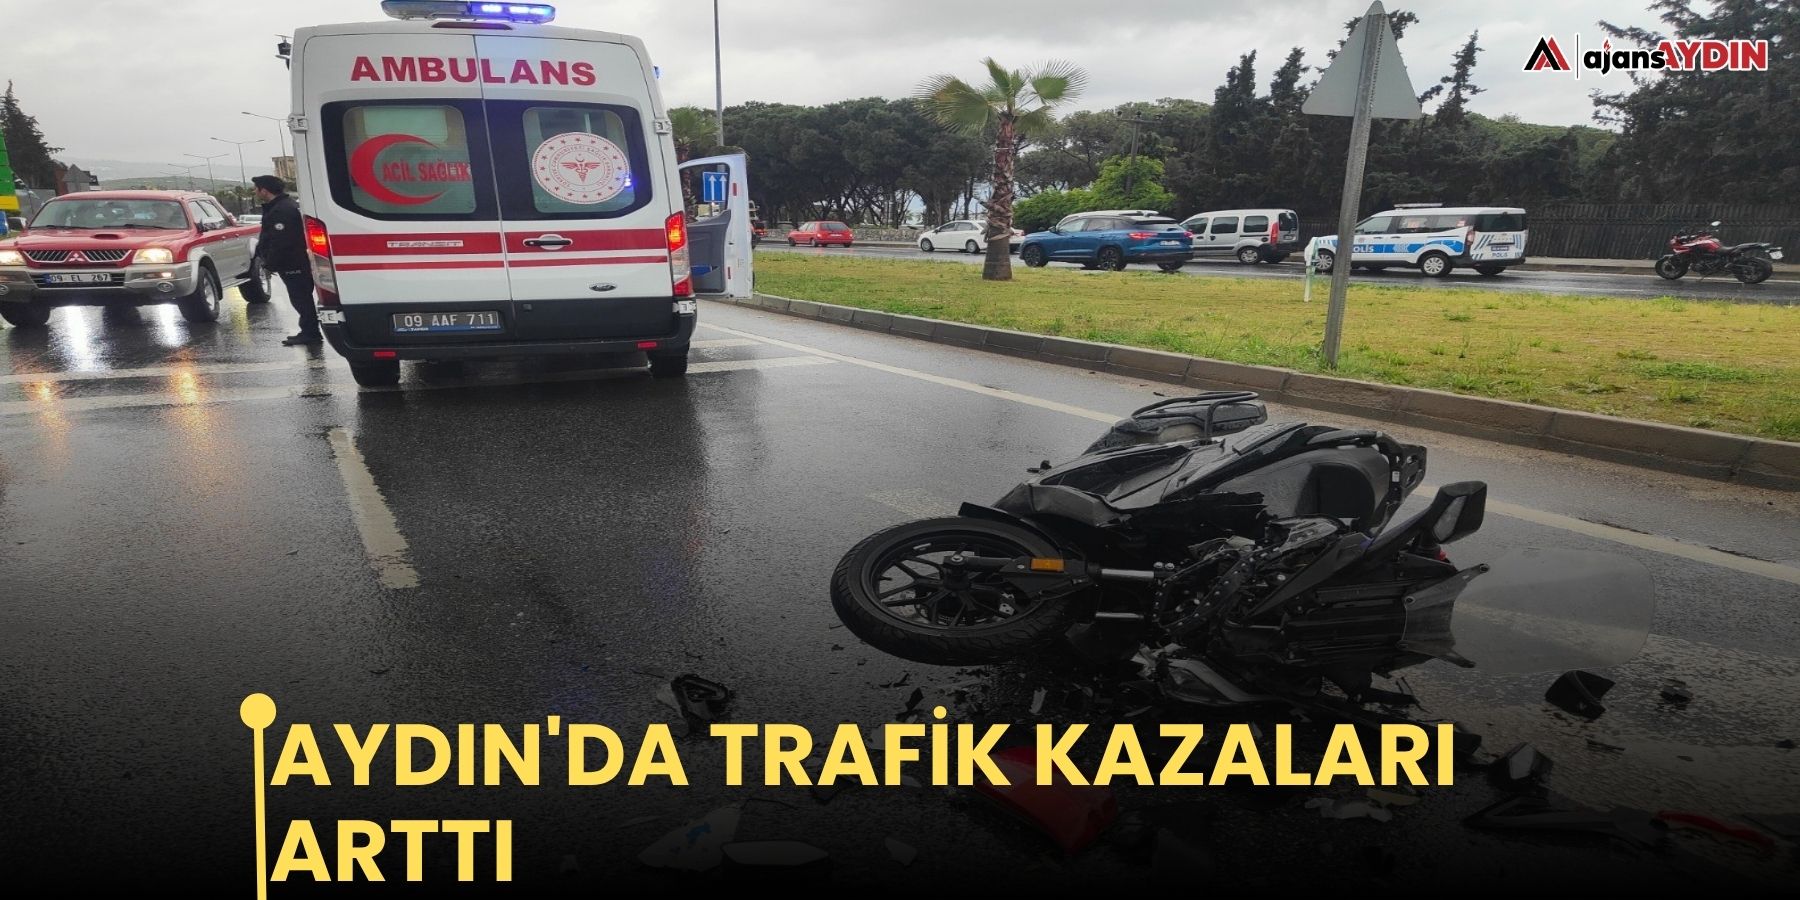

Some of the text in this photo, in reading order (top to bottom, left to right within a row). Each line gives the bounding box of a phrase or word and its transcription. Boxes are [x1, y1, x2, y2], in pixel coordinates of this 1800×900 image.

[351, 56, 597, 86] AMBULANS
[51, 274, 63, 282] 09
[70, 274, 83, 282] EL
[404, 313, 495, 327] 09 AAF 711
